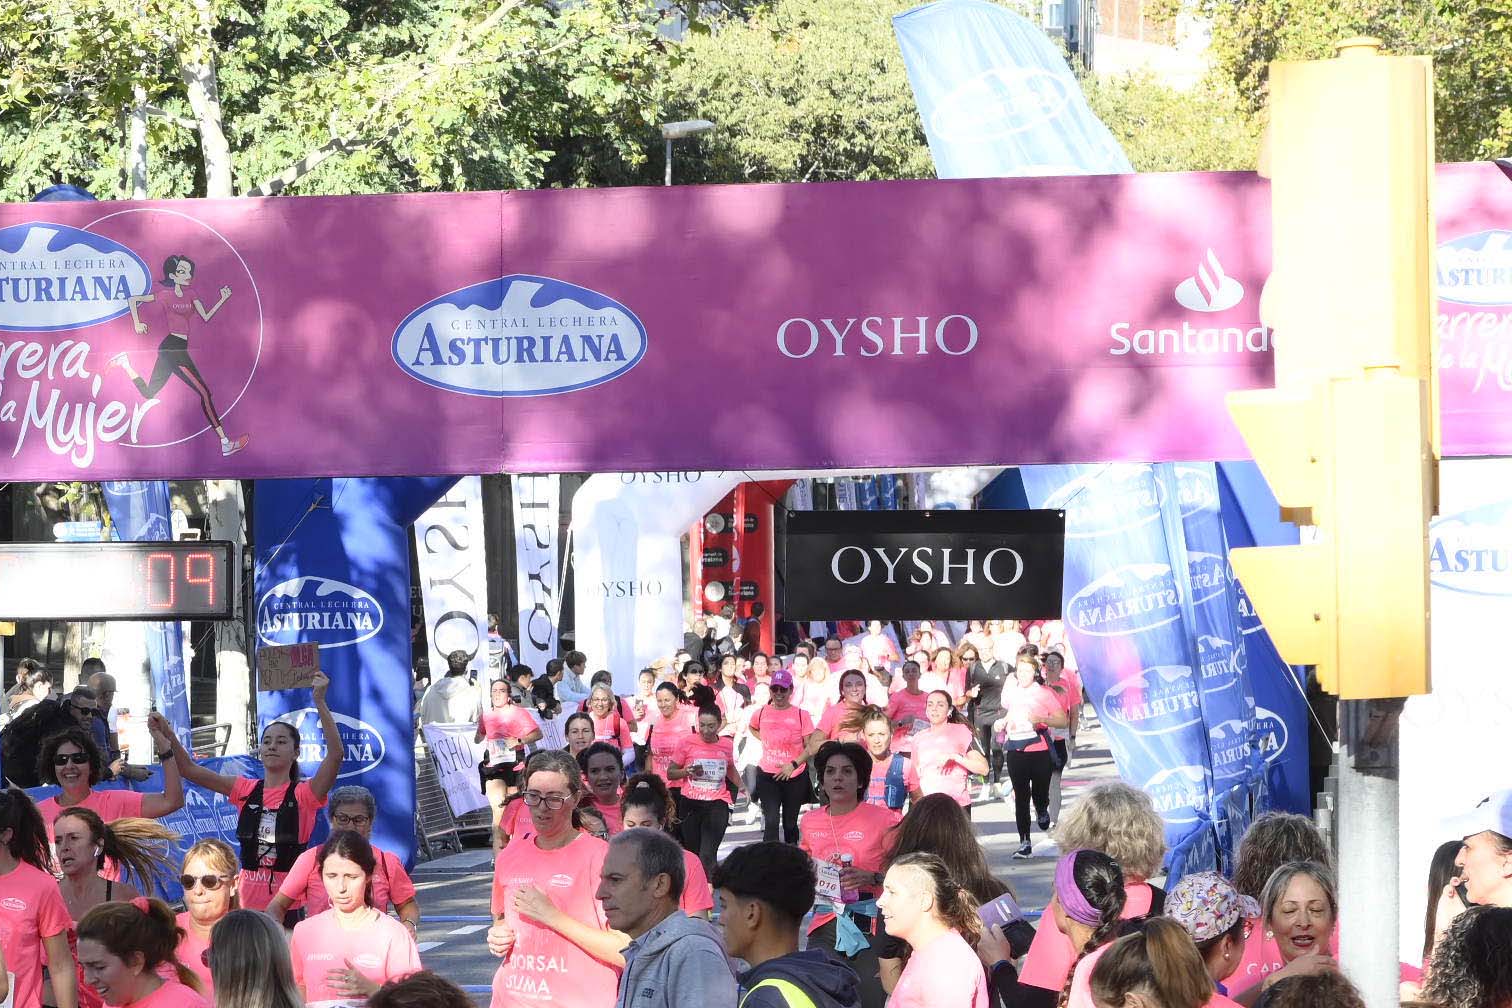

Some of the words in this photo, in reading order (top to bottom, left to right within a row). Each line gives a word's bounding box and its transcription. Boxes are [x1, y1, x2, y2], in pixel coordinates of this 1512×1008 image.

[54, 258, 127, 270] LECHERA
[450, 318, 531, 331] CENTRAL
[537, 315, 620, 328] LECHERA
[776, 313, 979, 359] OYSHO
[411, 322, 628, 369] ASTURIANA
[1110, 321, 1276, 356] Santand
[12, 373, 162, 468] Mujer
[831, 545, 1025, 587] OYSHO
[273, 601, 316, 610] CENTRAL
[321, 600, 370, 609] LECHERA
[261, 606, 375, 634] ASTURIANA
[819, 879, 837, 892] 016
[505, 975, 551, 994] SUMA
